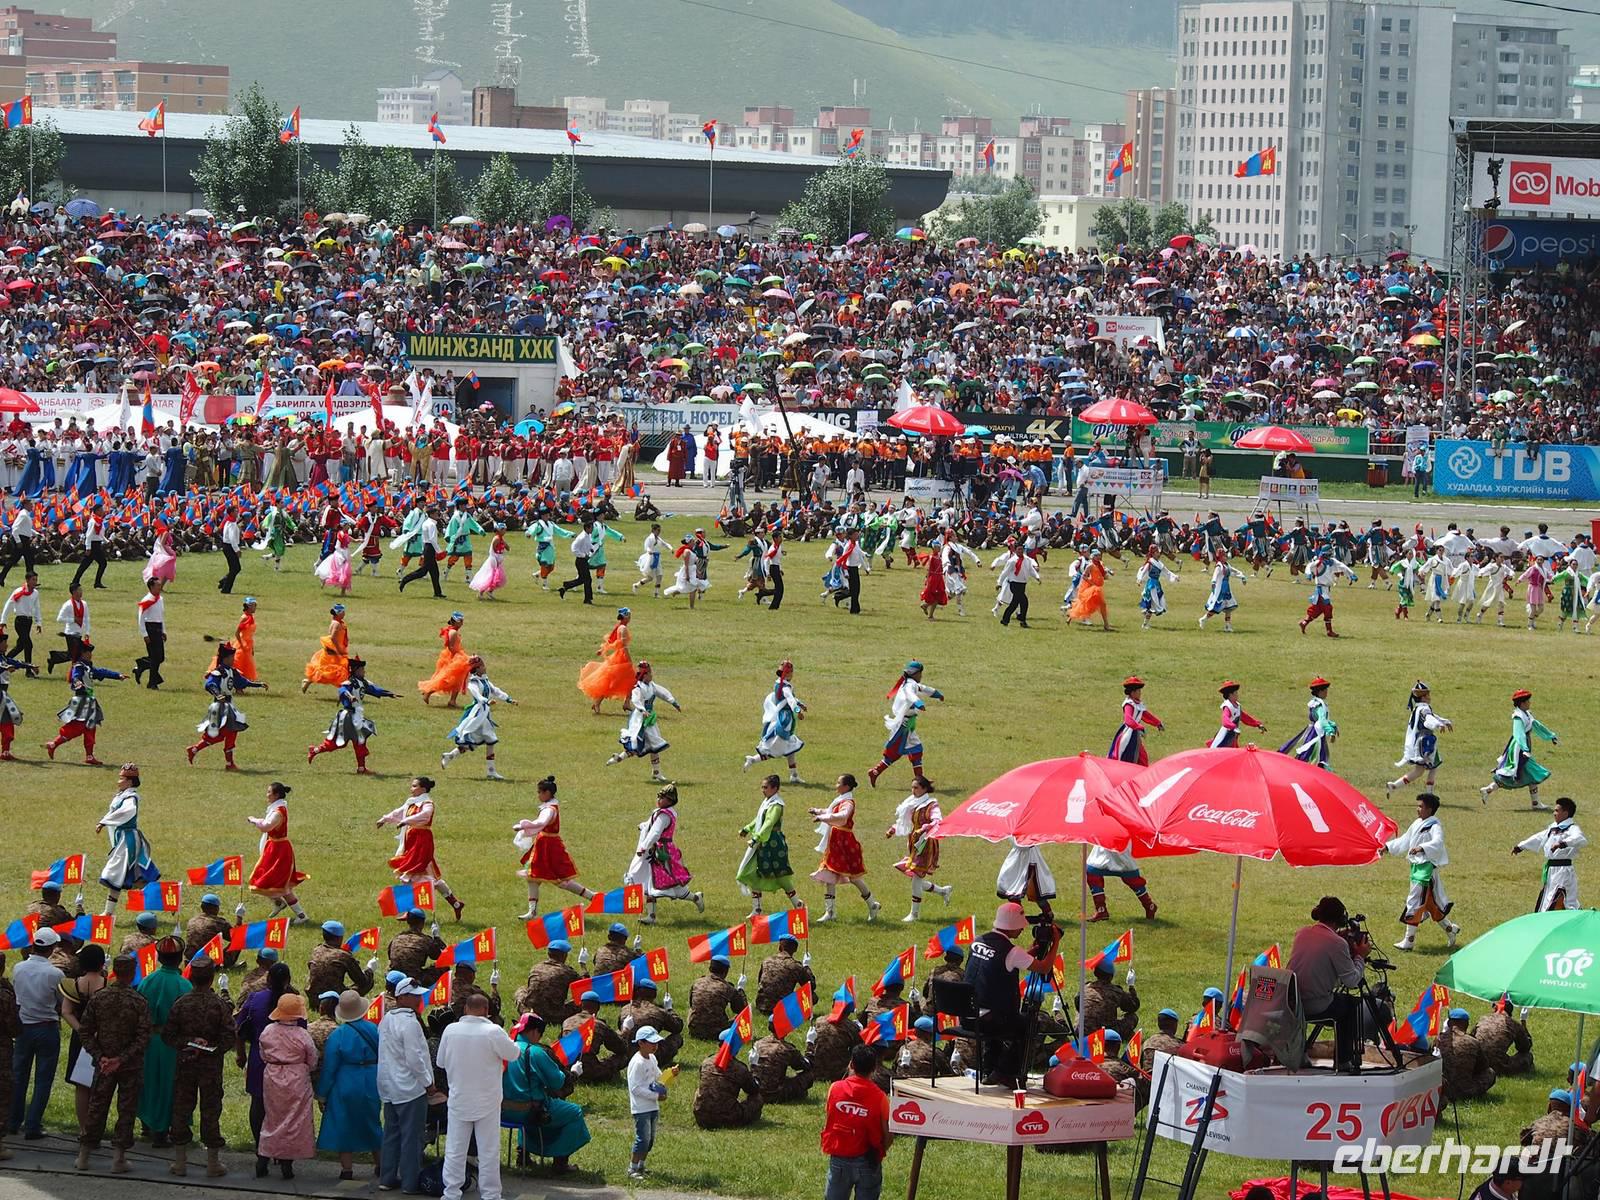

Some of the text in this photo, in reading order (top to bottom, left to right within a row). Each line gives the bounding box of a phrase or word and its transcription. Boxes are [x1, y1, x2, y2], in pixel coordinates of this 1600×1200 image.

[1521, 234, 1596, 258] pepsi
[410, 335, 555, 361] МИНЖЗАНД ХХК
[690, 411, 735, 425] HOTEL
[1025, 419, 1064, 440] 4K
[1485, 448, 1571, 482] TDB
[1447, 483, 1493, 493] ХУДАЛДАА
[1547, 487, 1570, 495] БАНК
[1188, 803, 1263, 829] Coca-Cola
[1304, 1101, 1363, 1142] 25
